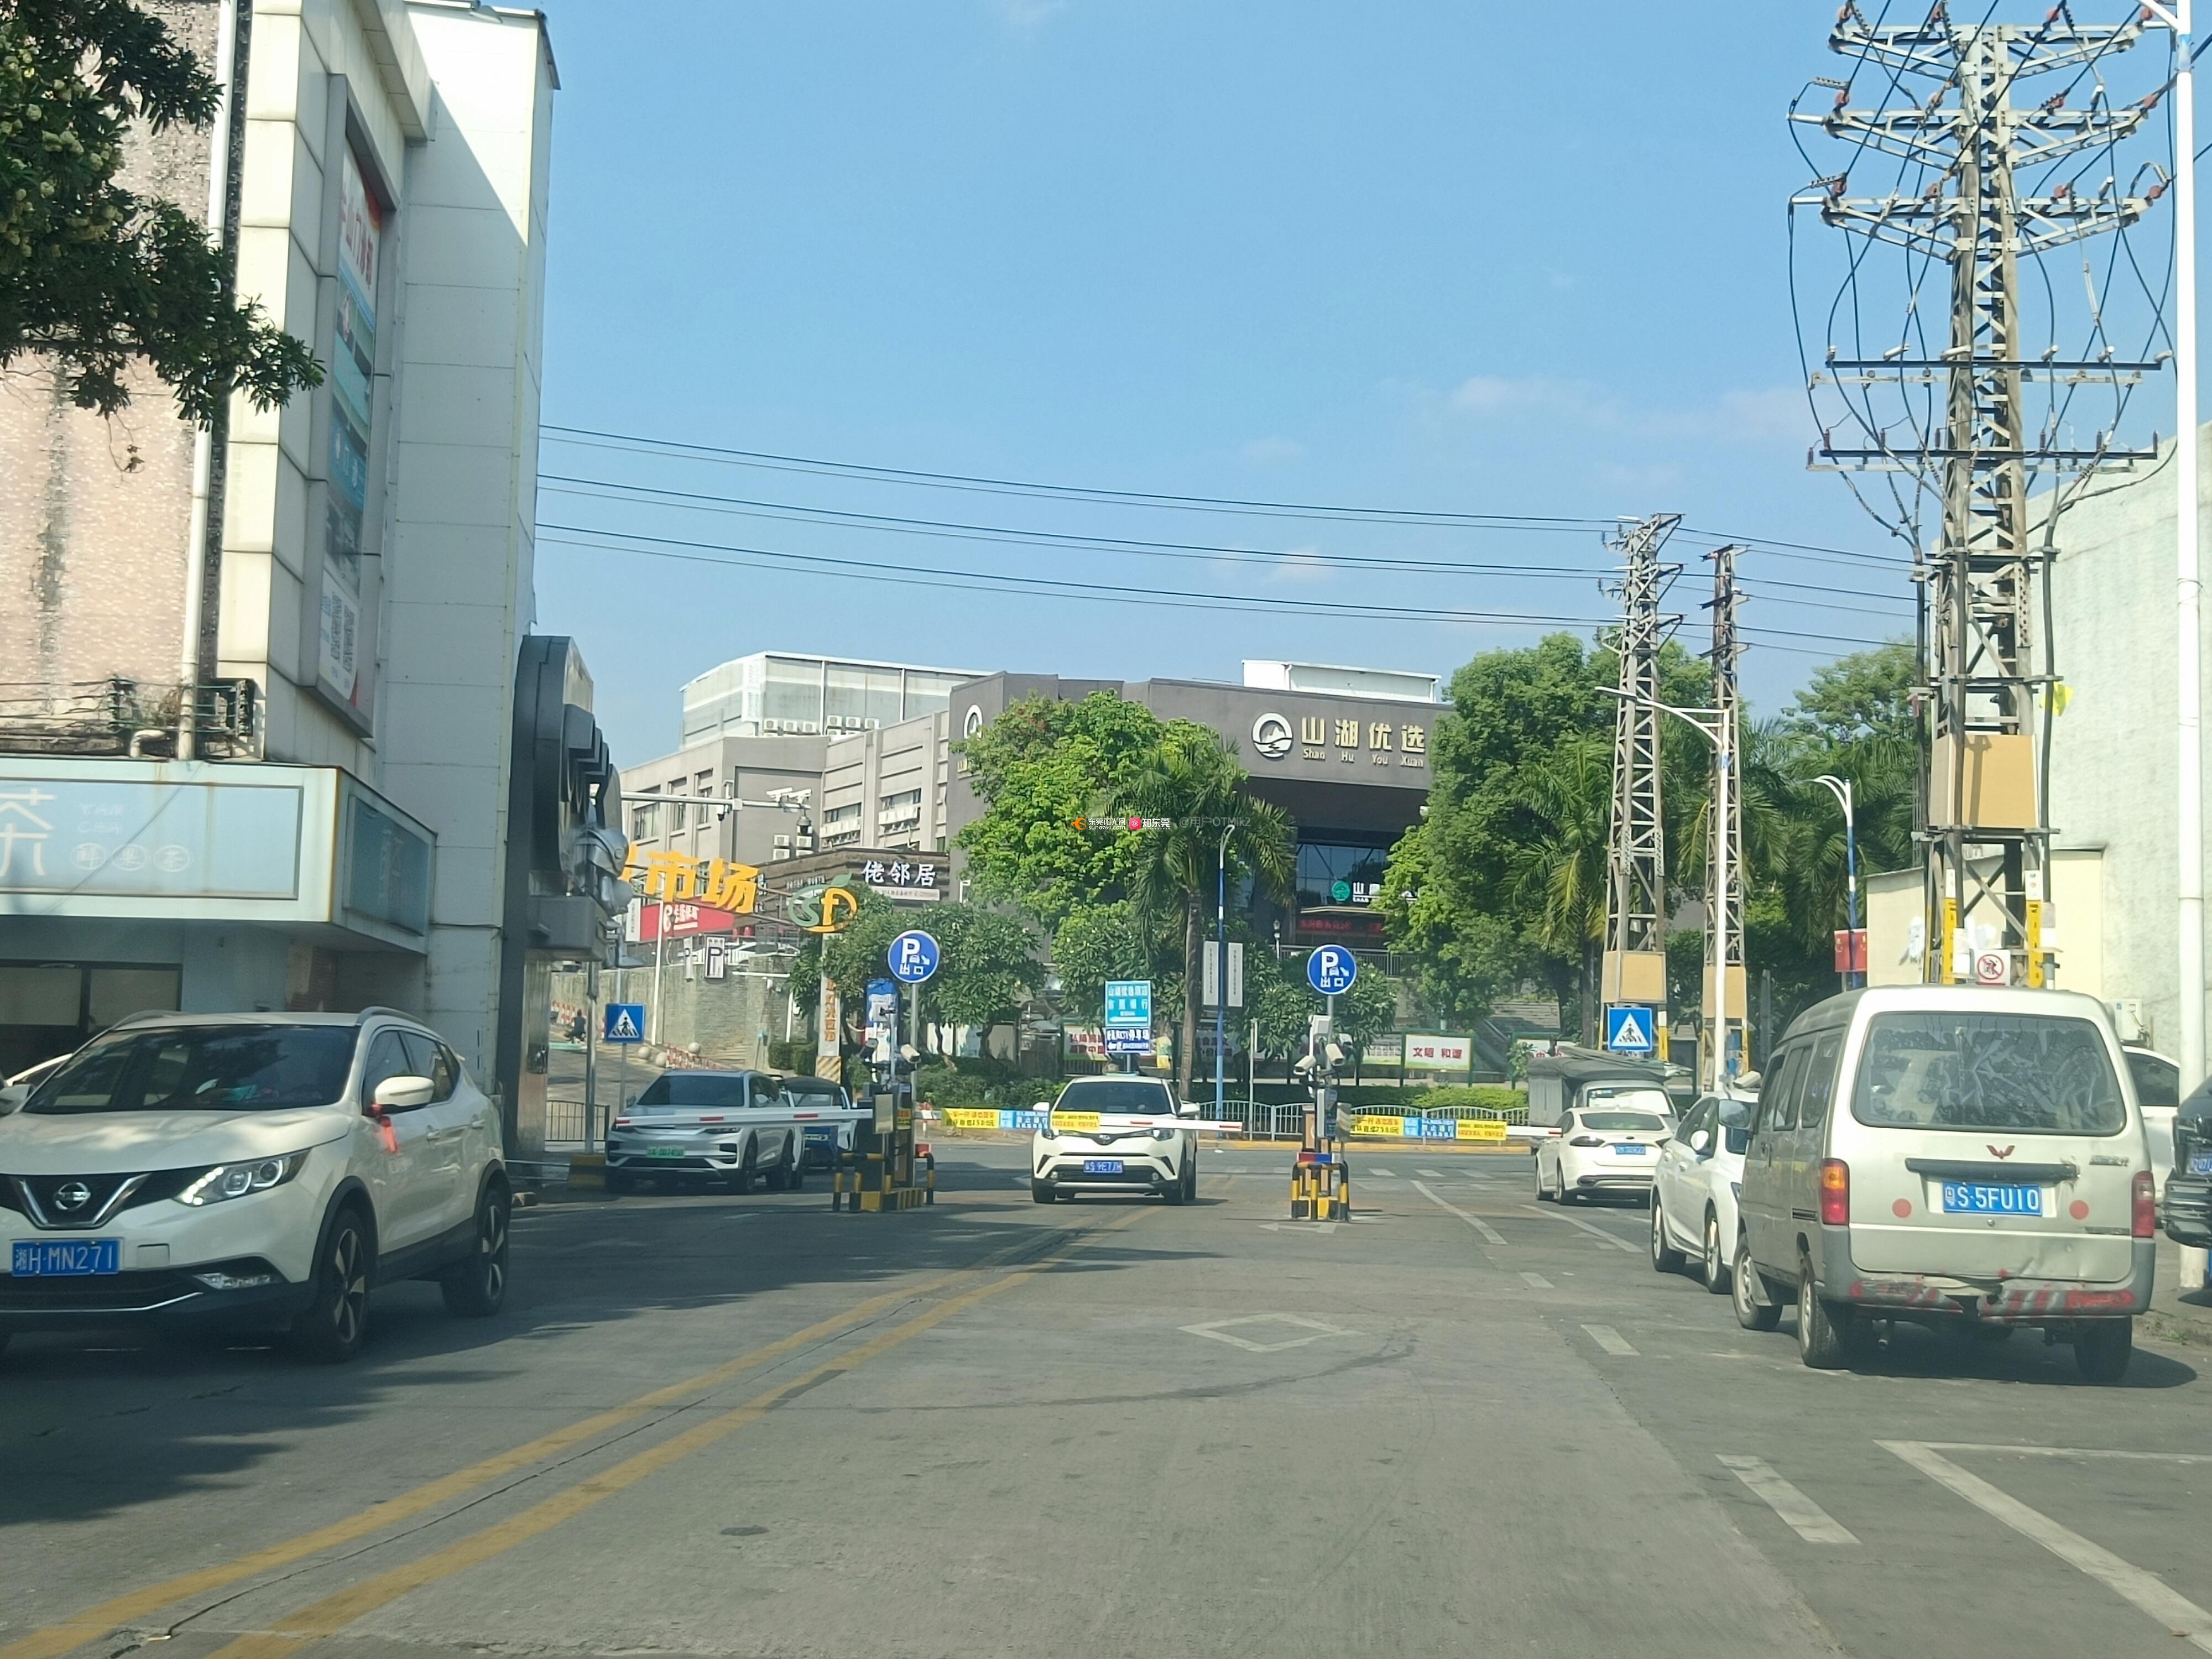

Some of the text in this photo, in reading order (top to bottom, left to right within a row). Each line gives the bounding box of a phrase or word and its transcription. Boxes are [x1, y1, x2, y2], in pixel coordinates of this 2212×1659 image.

[1301, 717, 1425, 753] 山湖优选
[1302, 749, 1423, 768] Shan Hu You Xuan
[618, 844, 760, 914] 市场
[861, 860, 936, 886] 佬邻居
[901, 938, 920, 964] P
[1321, 951, 1338, 977] P
[899, 963, 924, 975] 出口
[1320, 977, 1344, 988] 出口
